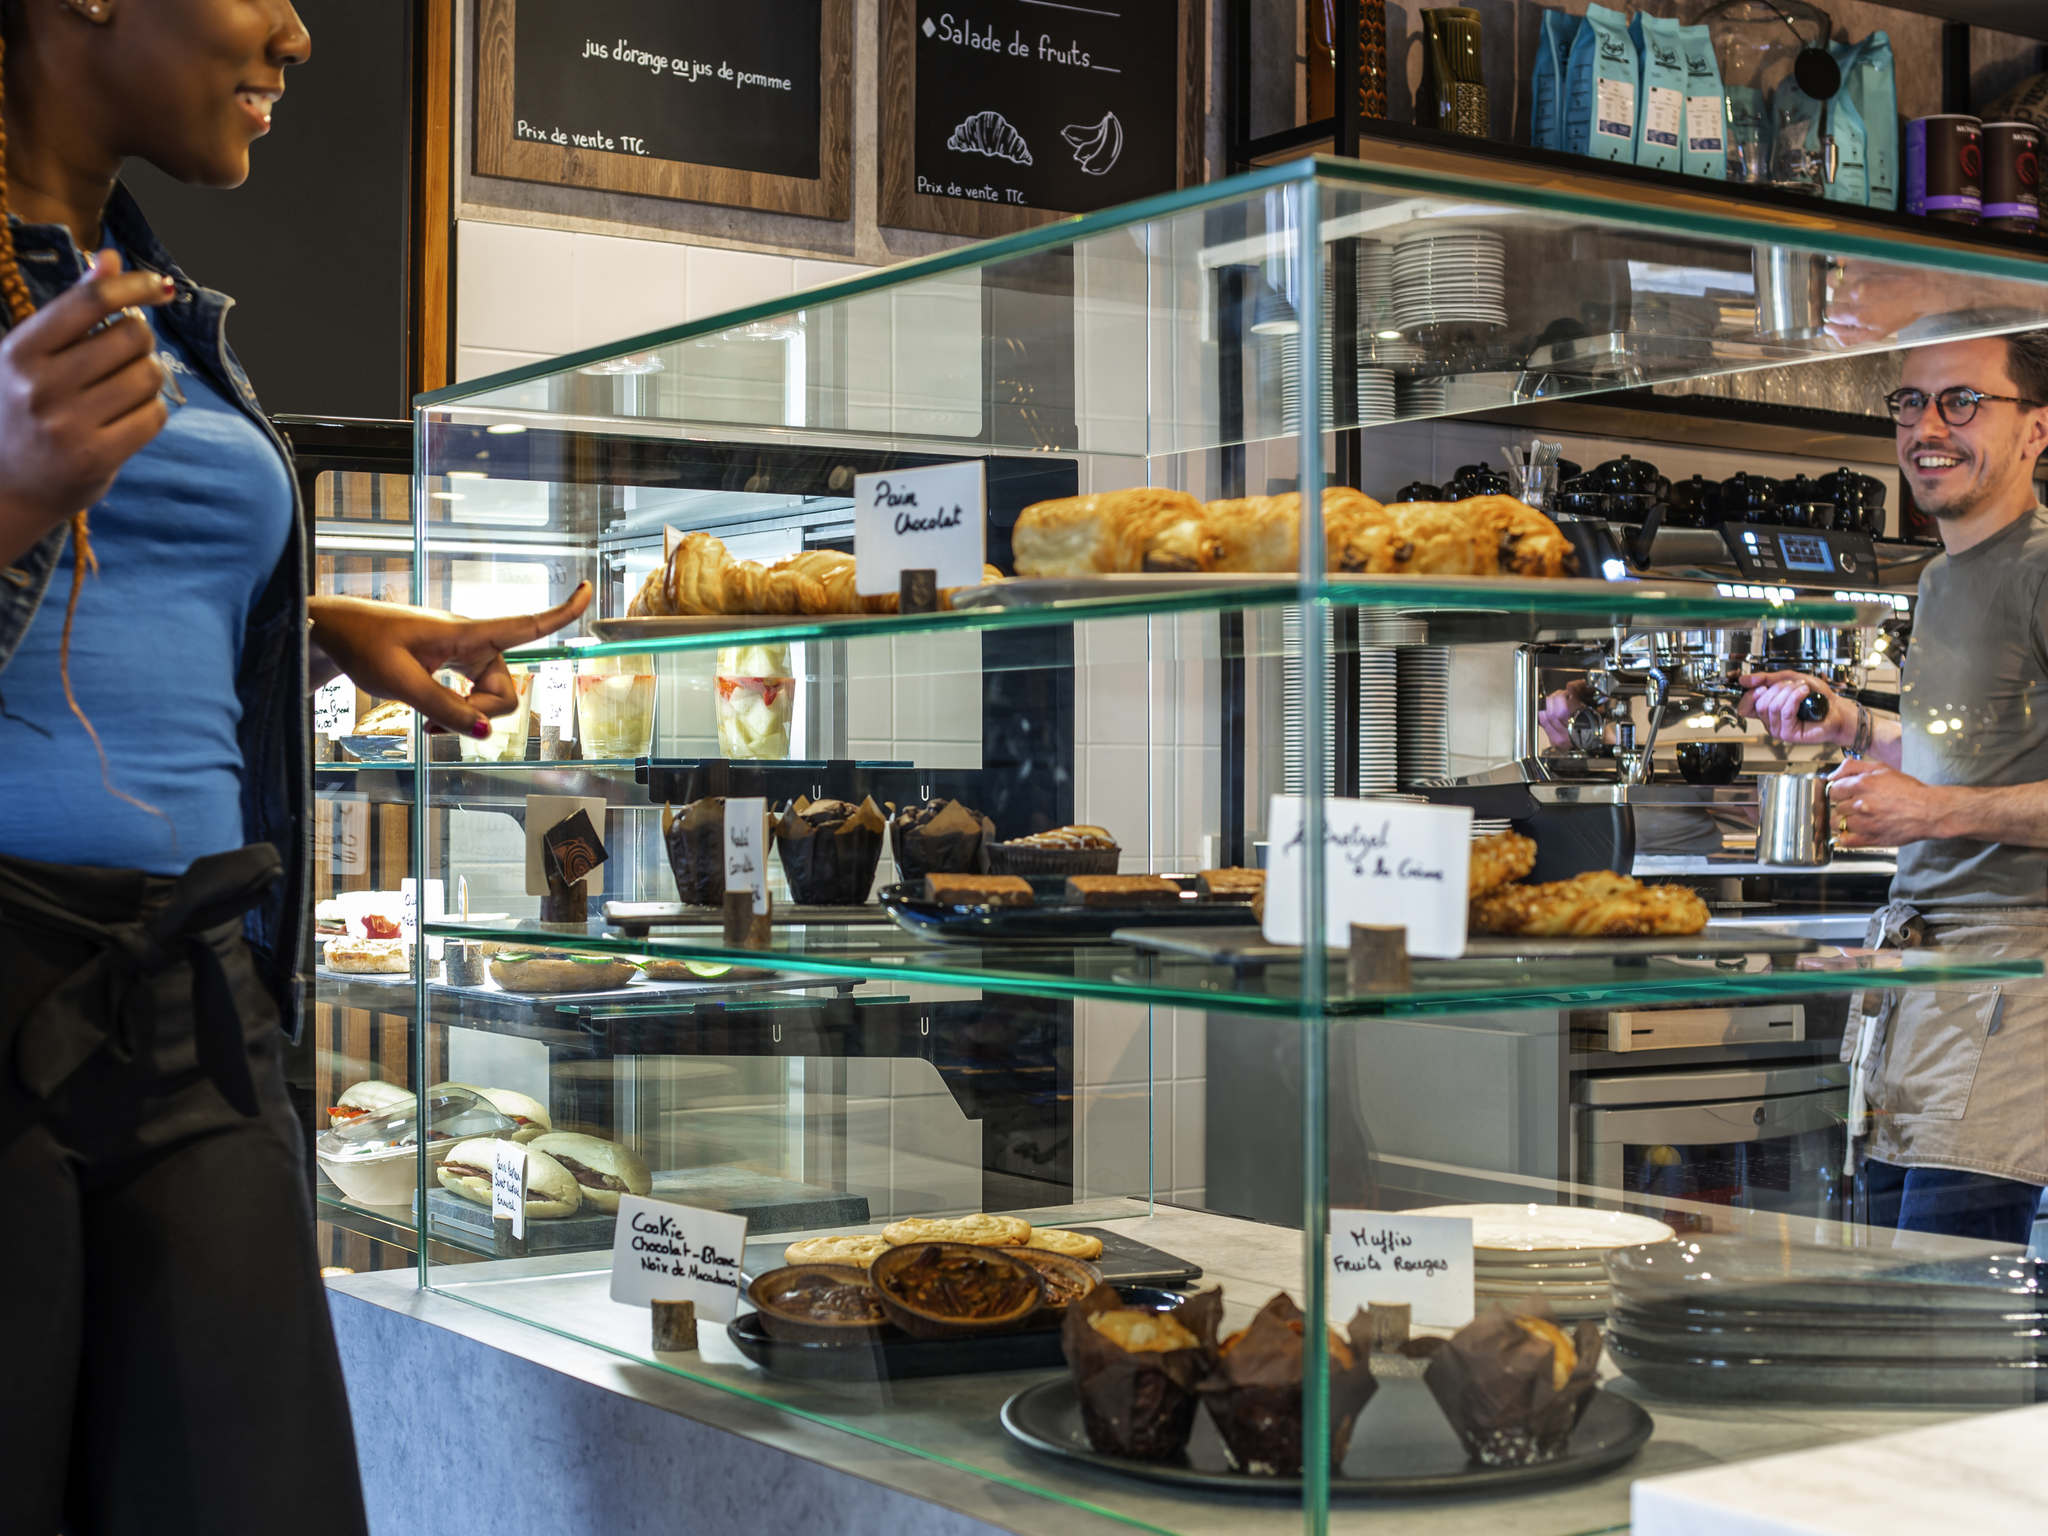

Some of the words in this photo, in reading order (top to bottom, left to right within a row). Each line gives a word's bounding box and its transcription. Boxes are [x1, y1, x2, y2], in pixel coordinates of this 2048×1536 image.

[938, 13, 1001, 52] Salade
[1008, 30, 1029, 57] de
[1038, 34, 1091, 67] fruits
[582, 39, 609, 58] jus
[612, 39, 668, 75] d'orange
[671, 58, 689, 75] ou
[689, 60, 712, 82] jus
[717, 61, 734, 80] de
[737, 71, 792, 91] pomme
[517, 120, 547, 140] Prix
[551, 127, 568, 144] de
[572, 130, 614, 149] vente
[620, 136, 650, 155] TTC.
[917, 176, 942, 193] Prix
[947, 182, 962, 196] de
[965, 184, 998, 201] vente
[874, 480, 918, 507] Pain
[895, 504, 962, 535] Chocolat
[1350, 1227, 1412, 1255] Muffin
[641, 1256, 669, 1273] Noix
[672, 1259, 685, 1276] de
[1333, 1254, 1382, 1273] Fruits
[1393, 1255, 1449, 1277] Rouges
